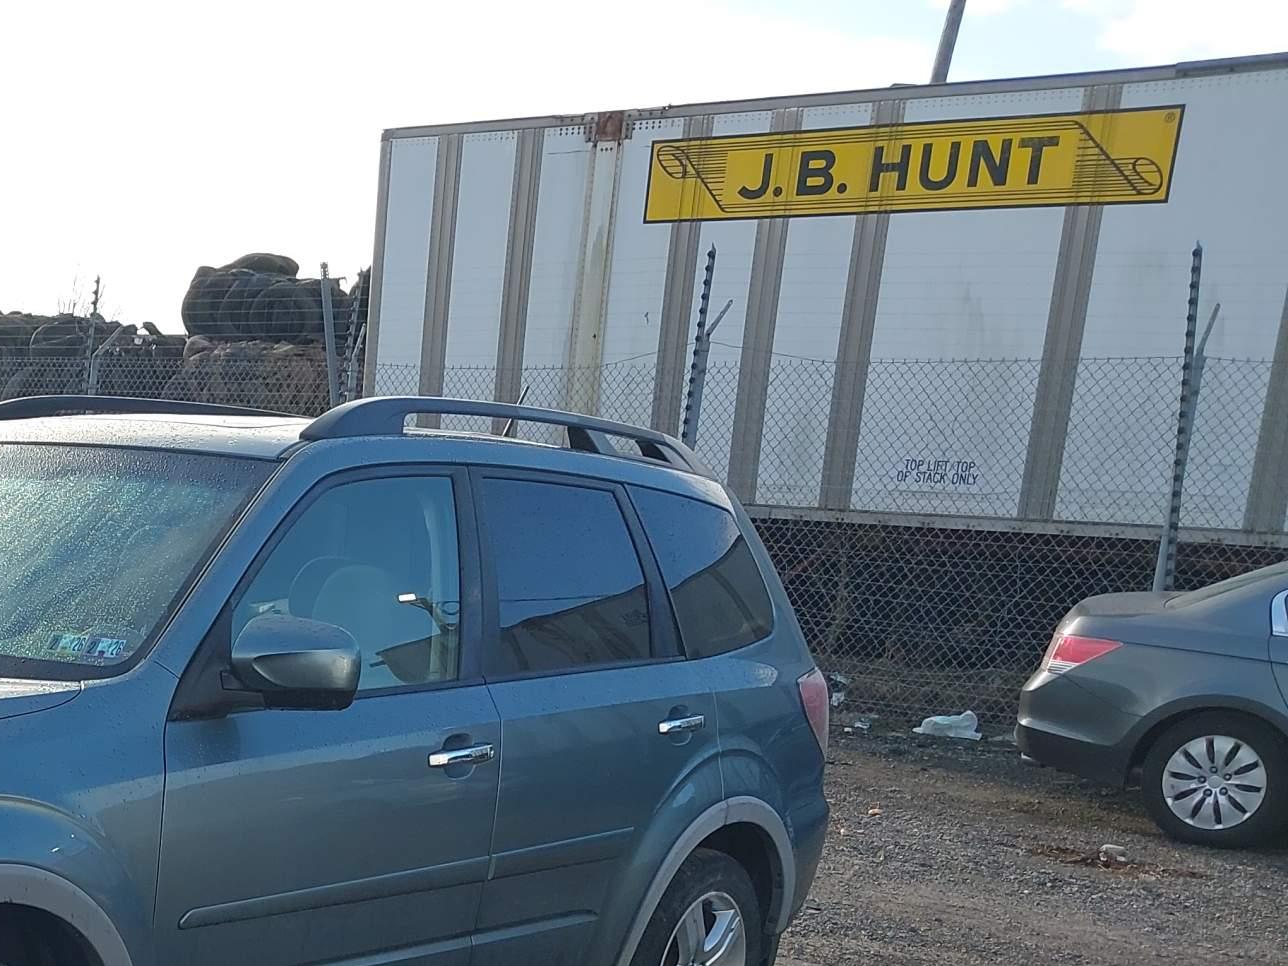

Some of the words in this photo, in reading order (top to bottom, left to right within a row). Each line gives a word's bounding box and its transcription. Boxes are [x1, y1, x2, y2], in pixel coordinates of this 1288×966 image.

[868, 135, 1060, 193] HUNT
[905, 459, 924, 471] TOP
[896, 470, 912, 482] OF
[914, 471, 948, 484] STACK
[951, 473, 979, 485] ONLY
